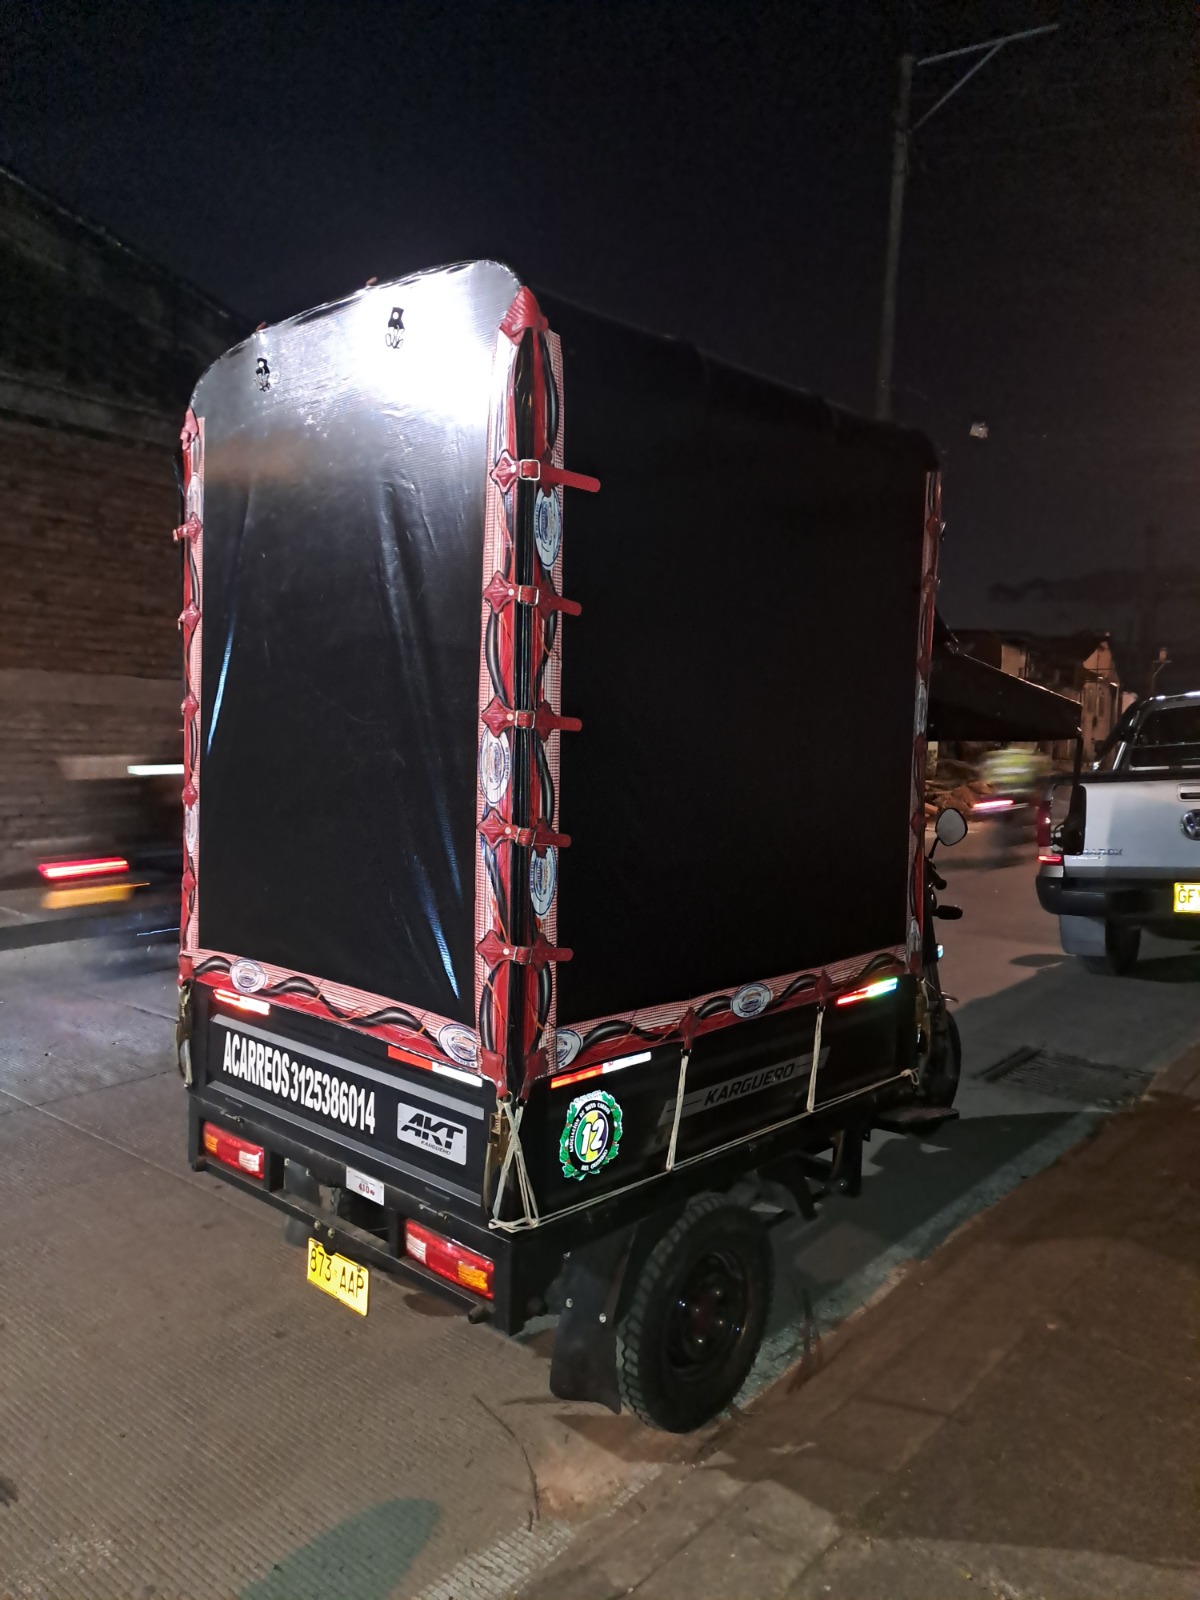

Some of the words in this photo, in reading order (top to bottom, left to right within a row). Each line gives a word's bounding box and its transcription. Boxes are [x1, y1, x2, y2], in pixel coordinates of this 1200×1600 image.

[1178, 889, 1200, 904] GF
[223, 1031, 290, 1098] ACARREOS
[290, 1061, 376, 1135] 3125386014
[704, 1063, 795, 1106] KARGUERO
[400, 1112, 464, 1150] AKT
[581, 1118, 605, 1156] 12
[310, 1247, 332, 1282] 873
[339, 1266, 365, 1299] AAP
